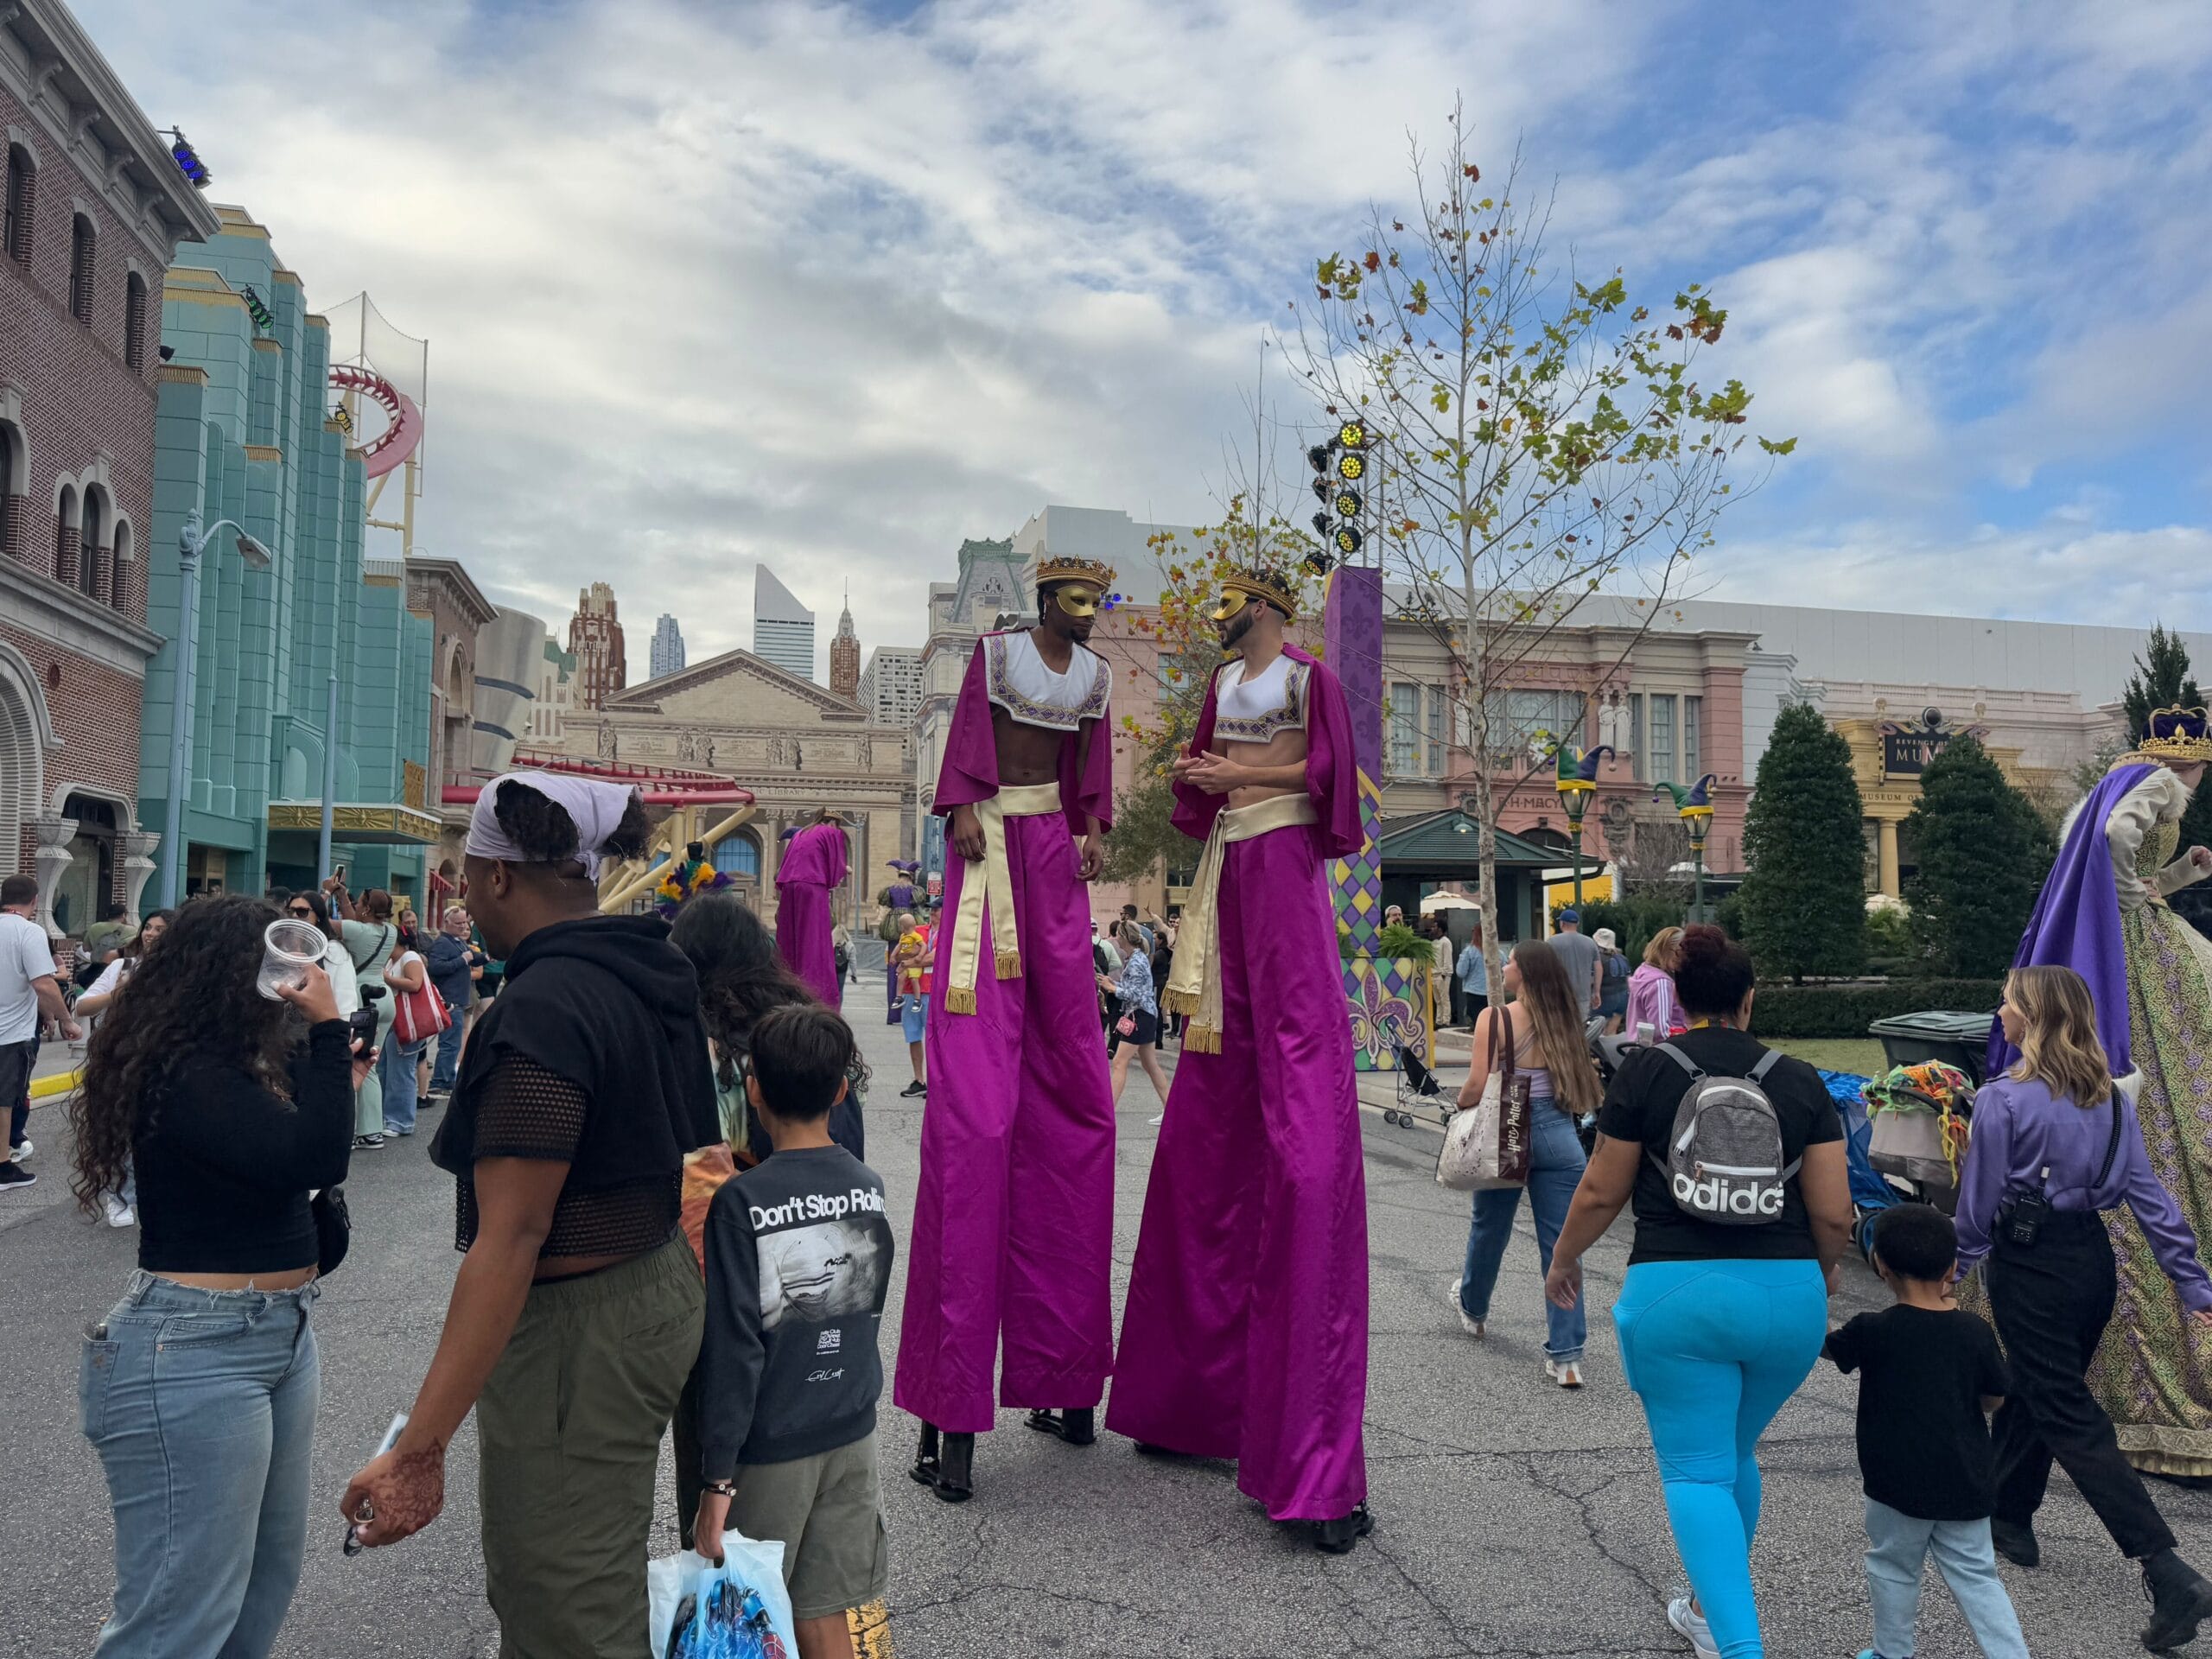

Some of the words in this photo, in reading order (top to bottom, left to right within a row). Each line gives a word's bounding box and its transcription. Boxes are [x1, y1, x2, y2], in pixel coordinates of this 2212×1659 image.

[1896, 738, 1935, 747] REVENGE
[1859, 792, 1901, 801] MUSEUM
[1507, 1099, 1521, 1128] Potter
[1507, 1126, 1521, 1153] Harry
[749, 1196, 805, 1230] Don't
[805, 1194, 849, 1220] Stop
